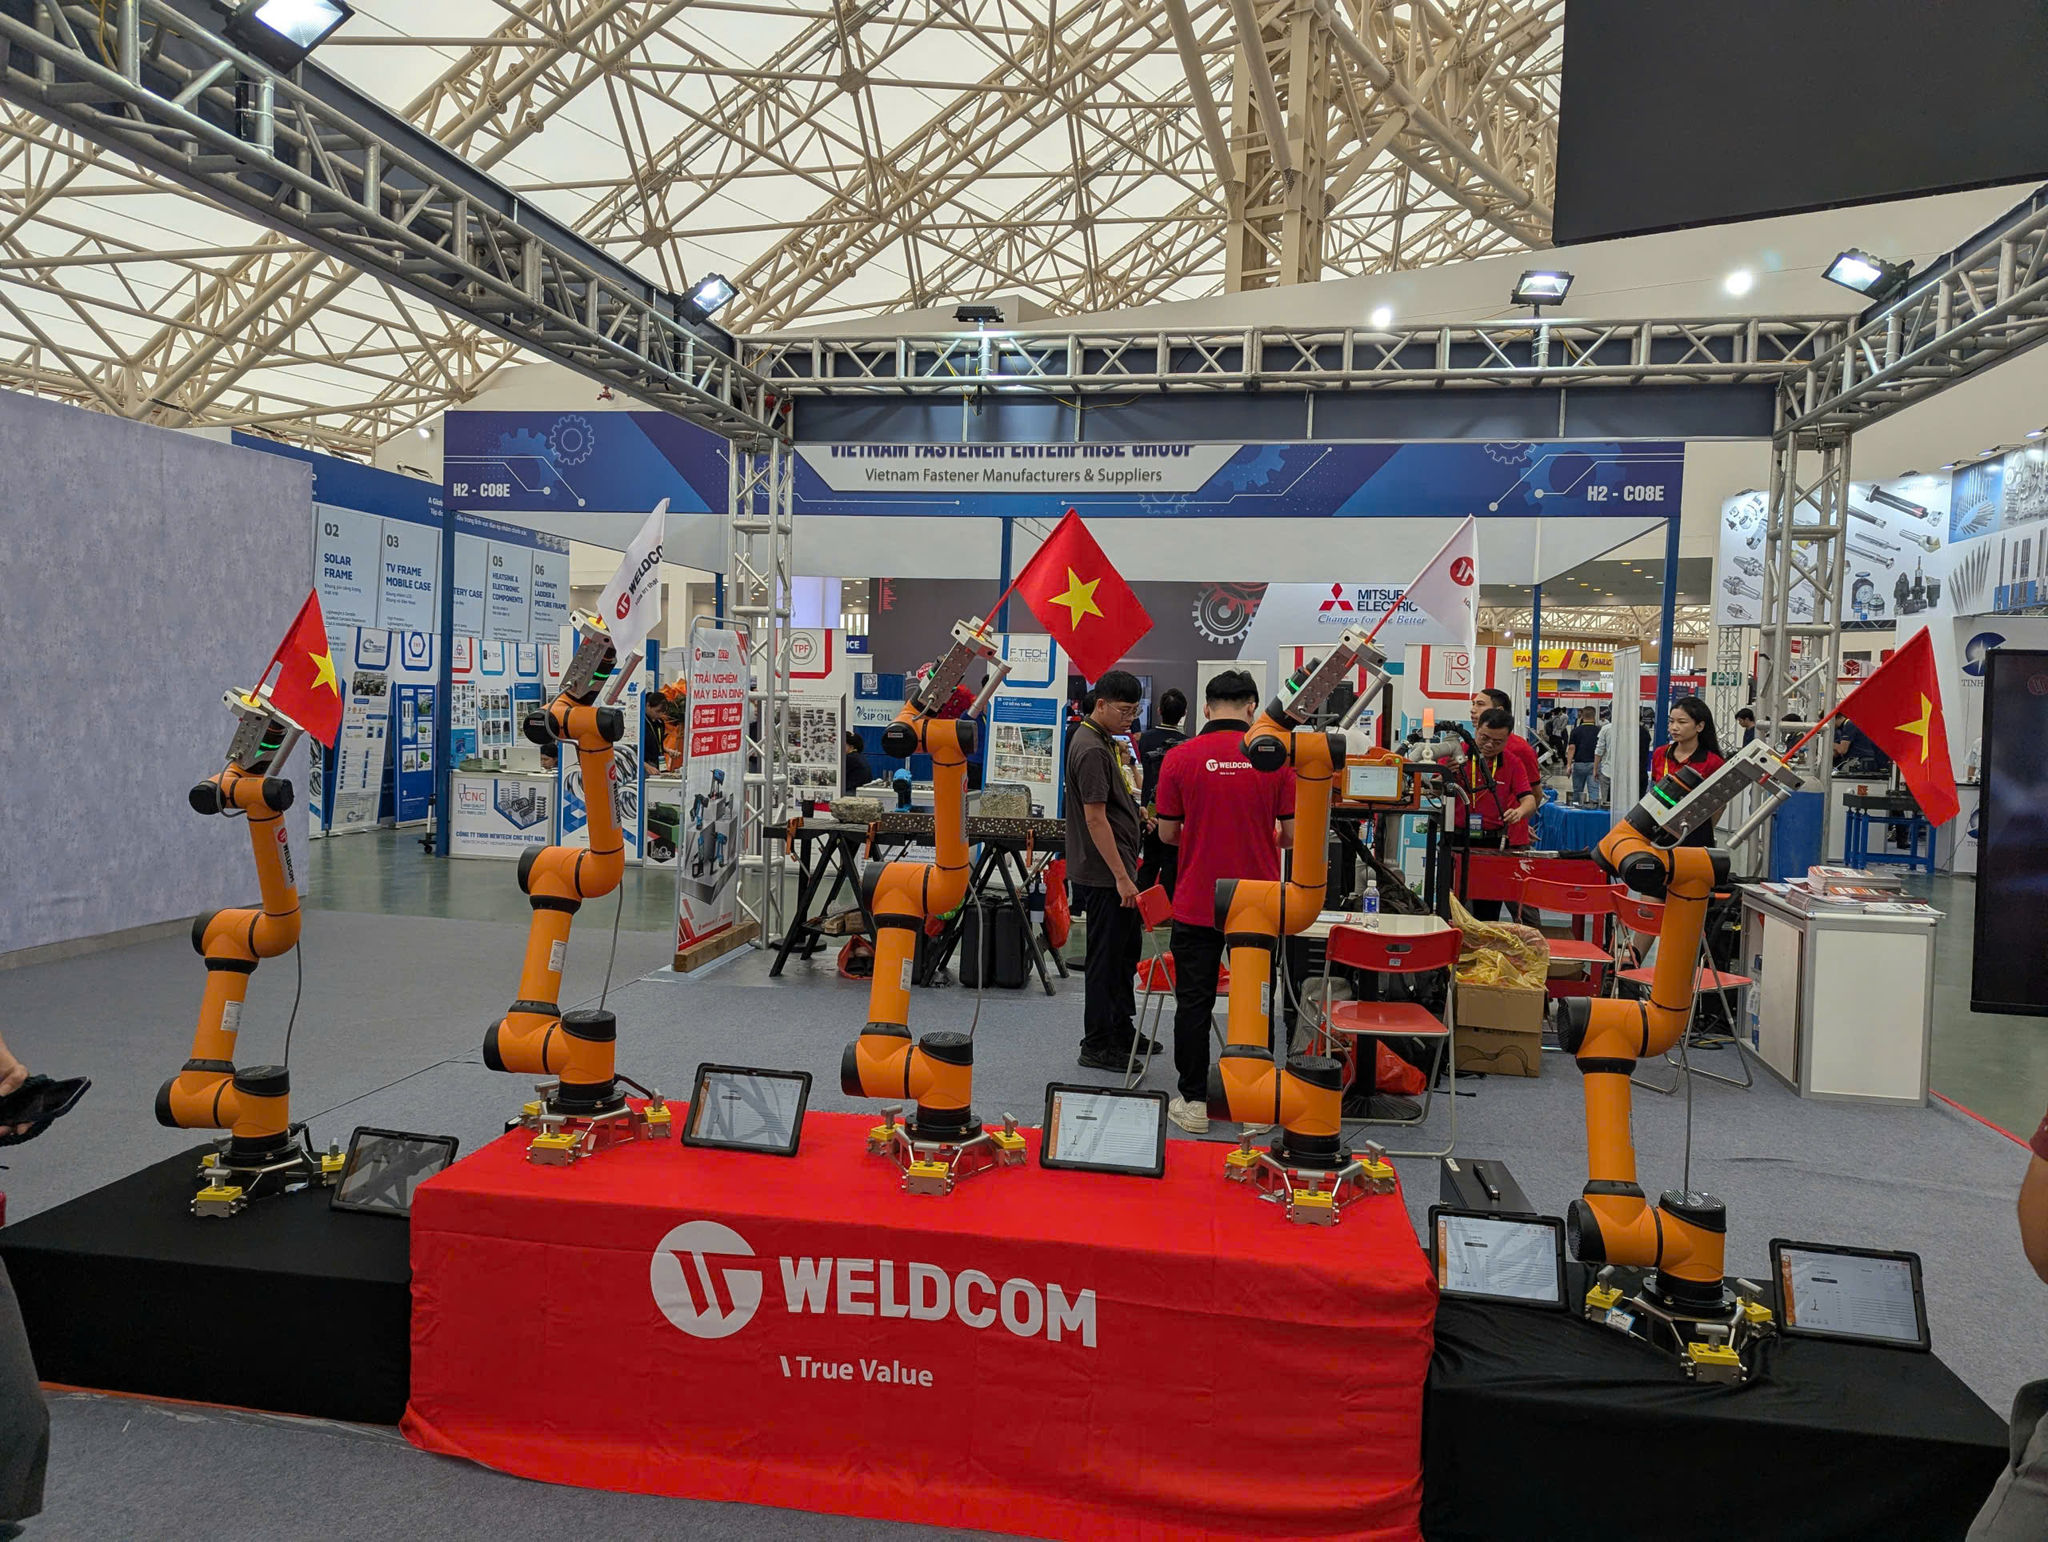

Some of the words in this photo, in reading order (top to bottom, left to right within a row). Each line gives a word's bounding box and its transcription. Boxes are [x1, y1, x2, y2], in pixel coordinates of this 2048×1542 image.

[865, 468, 919, 482] Vietnam
[923, 468, 980, 482] Fastener
[982, 468, 1081, 482] Manufacturers
[1084, 468, 1095, 482] &
[1099, 467, 1162, 485] Suppliers
[453, 483, 469, 497] H2
[1587, 485, 1608, 501] H2
[324, 523, 339, 538] 02
[386, 534, 399, 548] 03
[324, 553, 352, 566] SOLAR
[492, 555, 503, 568] 05
[324, 568, 353, 580] FRAME
[386, 563, 396, 573] TV
[397, 564, 422, 577] FRAME
[535, 565, 545, 576] 06
[629, 545, 663, 595] WELDCO
[386, 576, 413, 590] MOBILE
[414, 580, 432, 592] CASE
[454, 587, 468, 597] TERY
[469, 589, 483, 599] CASE
[1318, 614, 1358, 625] Changes
[1397, 614, 1426, 625] Better
[794, 644, 809, 653] TPF
[1009, 648, 1018, 657] F
[1018, 648, 1048, 657] TECH
[1591, 657, 1613, 666] FANUC
[862, 713, 875, 721] SIP
[877, 712, 892, 721] OIL
[1219, 761, 1253, 769] WELDCOM
[465, 791, 486, 802] CNC
[779, 1255, 1098, 1349] WELDCOM
[796, 1356, 854, 1380] True
[859, 1359, 934, 1387] Value
